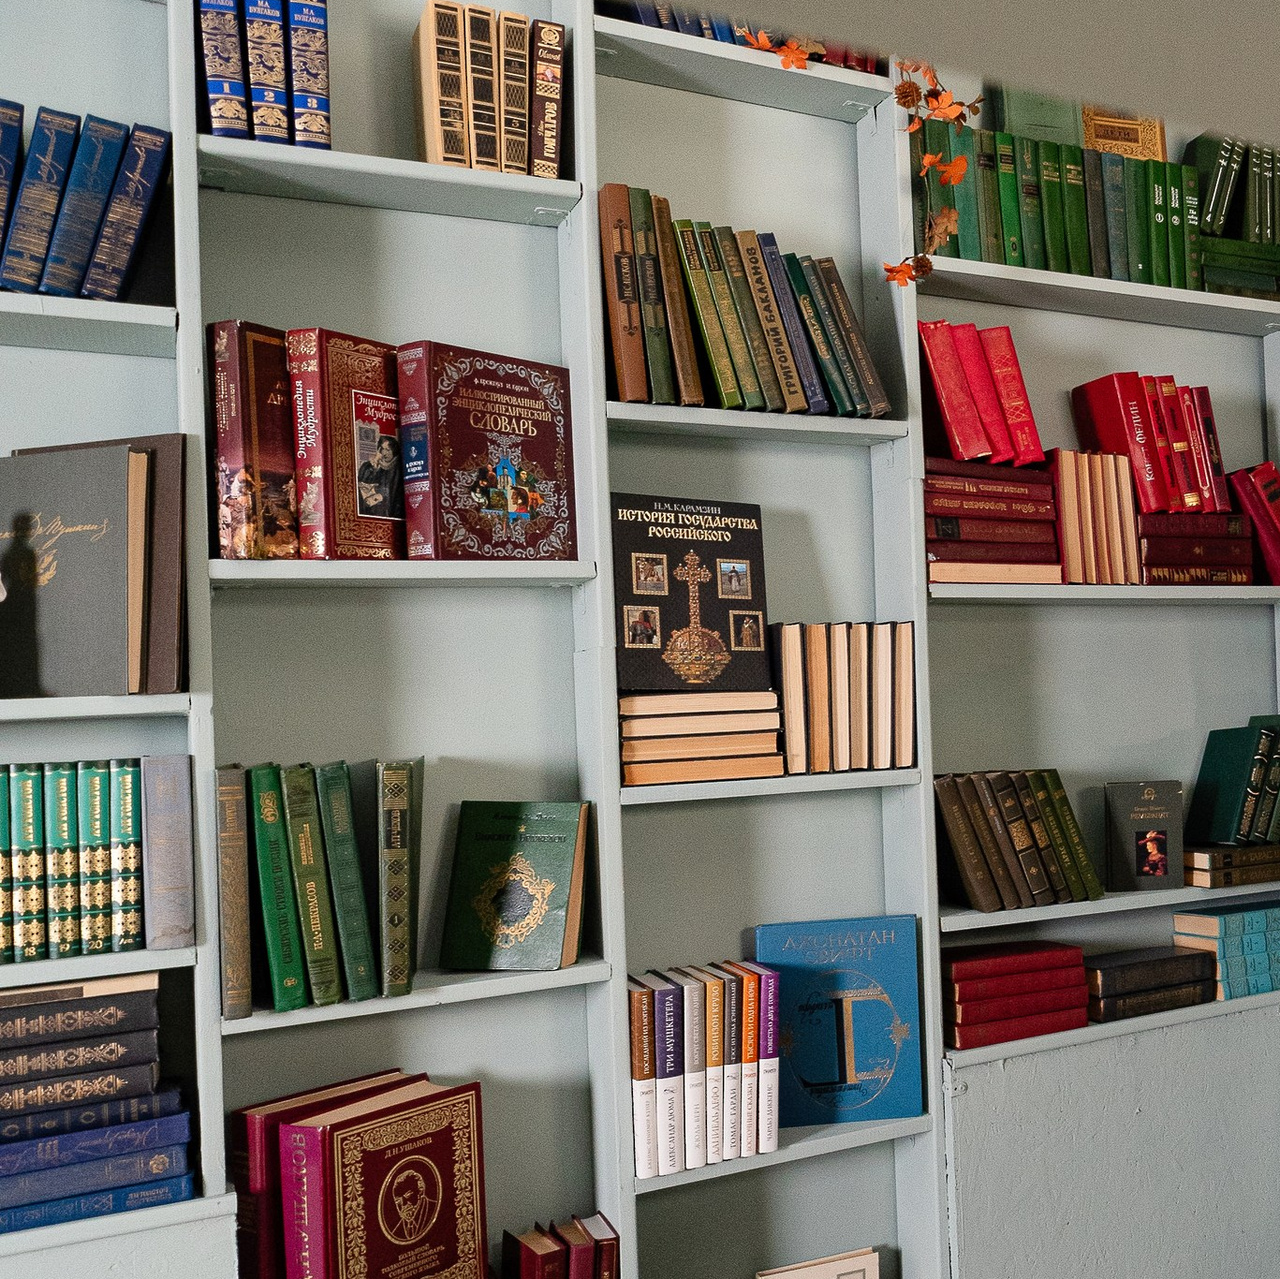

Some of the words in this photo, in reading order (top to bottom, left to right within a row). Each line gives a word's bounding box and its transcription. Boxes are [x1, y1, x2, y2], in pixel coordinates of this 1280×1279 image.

[223, 83, 230, 93] 1
[264, 91, 275, 102] 2
[307, 98, 318, 108] 3
[544, 102, 558, 158] ГОНЧАРОВ
[746, 246, 776, 323] БАКЛАНОВ
[766, 327, 799, 396] ГРИГОРИЙ
[356, 394, 398, 412] Энциклоп
[452, 396, 552, 422] ЭНЦИКЛОПЕДИЧЕСКИЙ
[459, 387, 545, 410] ИЛЛЮСТРИРОВАННЫЙ
[295, 380, 307, 459] Энциклопедия
[306, 389, 317, 447] Мудрости
[365, 407, 398, 421] Мудрос
[469, 411, 538, 437] СЛОВАРЬ
[617, 508, 675, 523] ИСТОРИЯ
[678, 513, 759, 531] ГОСУДАРСТВА
[647, 525, 732, 543] РОССИЙСКОГО
[24, 946, 37, 957] 18
[59, 943, 71, 953] 19
[88, 940, 103, 950] 20
[782, 929, 896, 951] ДЖОНАТАН
[804, 946, 876, 965] СВИФТ
[666, 994, 674, 1052] МУШКЕТЕРА
[666, 1053, 675, 1073] ТРИ
[668, 1096, 676, 1122] ДЮМА
[712, 1086, 720, 1113] ДЕФО
[668, 1124, 676, 1168] АЛЕКСАНДР
